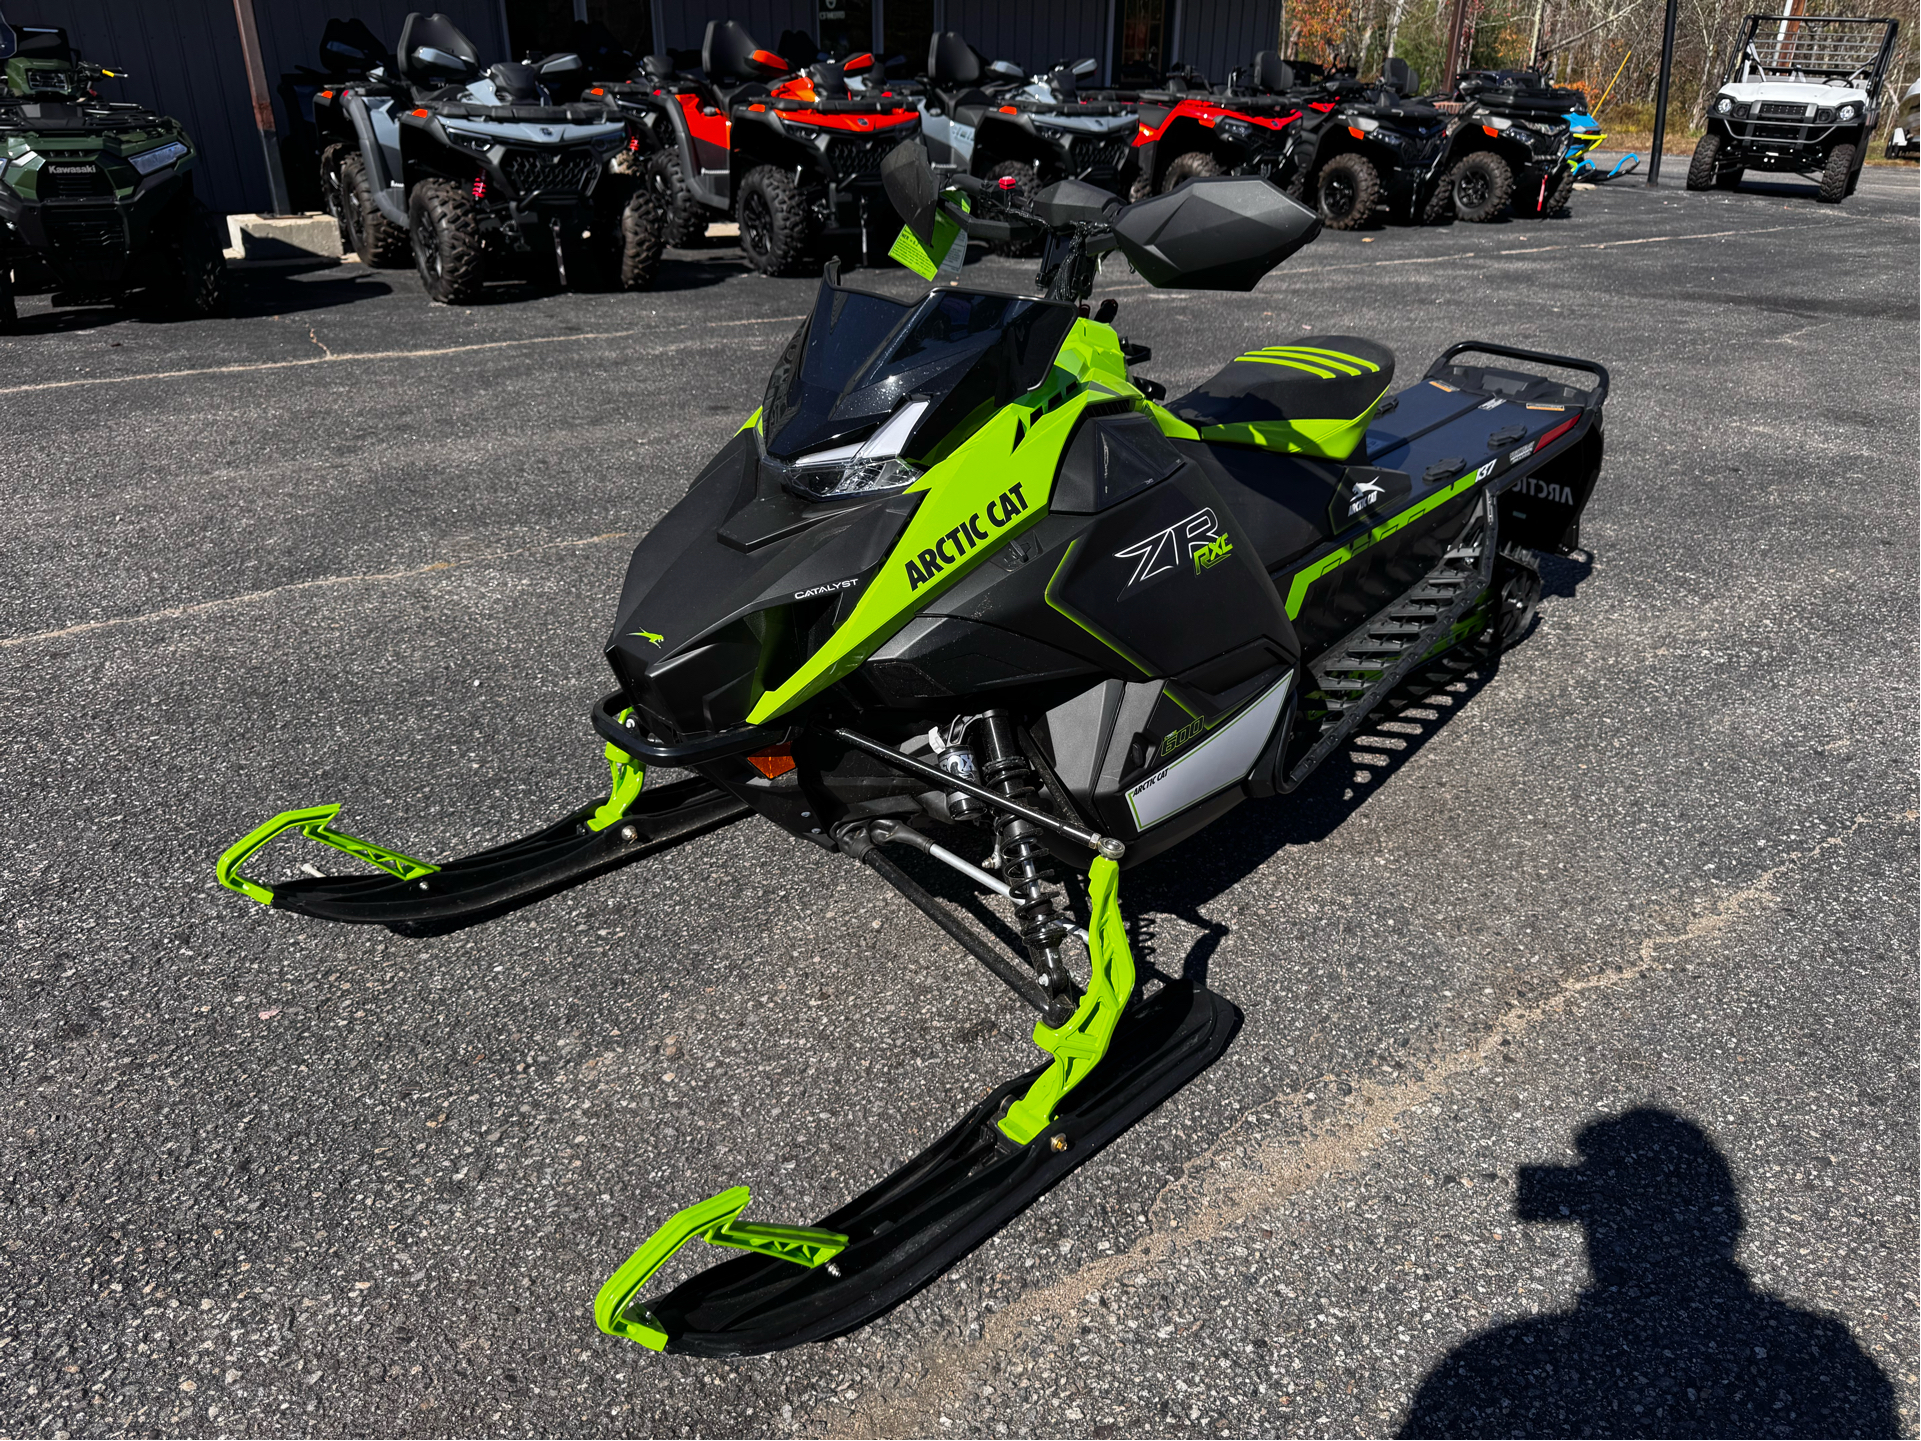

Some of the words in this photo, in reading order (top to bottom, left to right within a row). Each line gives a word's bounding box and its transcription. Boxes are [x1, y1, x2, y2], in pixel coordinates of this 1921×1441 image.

[48, 165, 96, 174] Kawasaki
[1474, 458, 1498, 483] 137
[1347, 496, 1368, 518] ARCTIC
[1367, 490, 1378, 505] CAT
[904, 513, 989, 592] ARCTIC
[986, 481, 1029, 528] CAT
[1113, 506, 1220, 588] ZR
[1193, 532, 1234, 576] RXC
[794, 578, 859, 600] CATALYST
[1161, 715, 1204, 757] 600
[1132, 775, 1157, 797] ARCTIC
[1156, 768, 1169, 782] CAT
